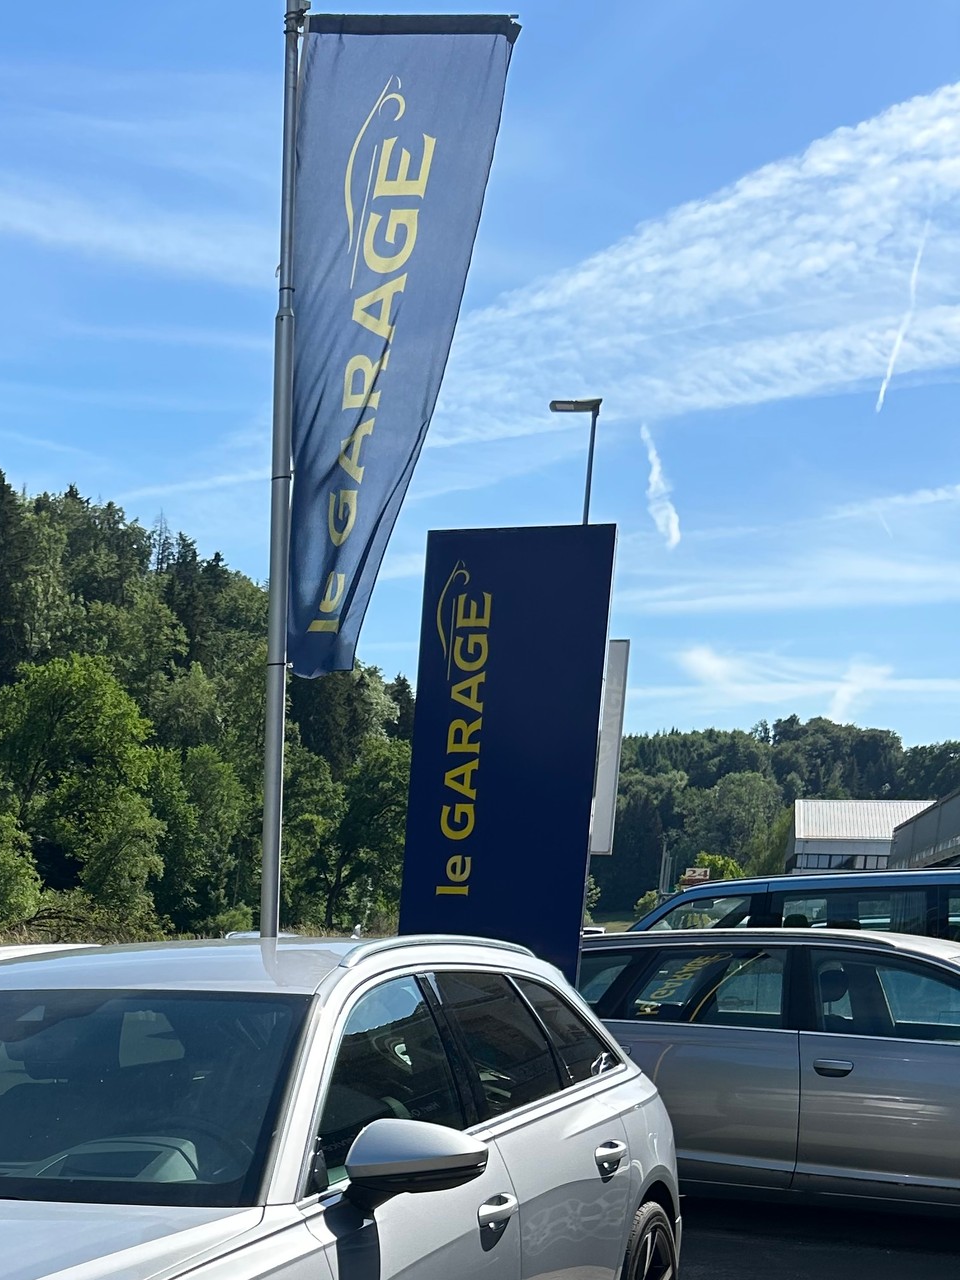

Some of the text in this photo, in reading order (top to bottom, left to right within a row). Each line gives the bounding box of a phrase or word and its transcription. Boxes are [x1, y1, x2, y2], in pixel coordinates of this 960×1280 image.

[306, 132, 436, 635] le GARAGE
[435, 591, 492, 896] le GARAGE
[687, 869, 709, 878] 24
